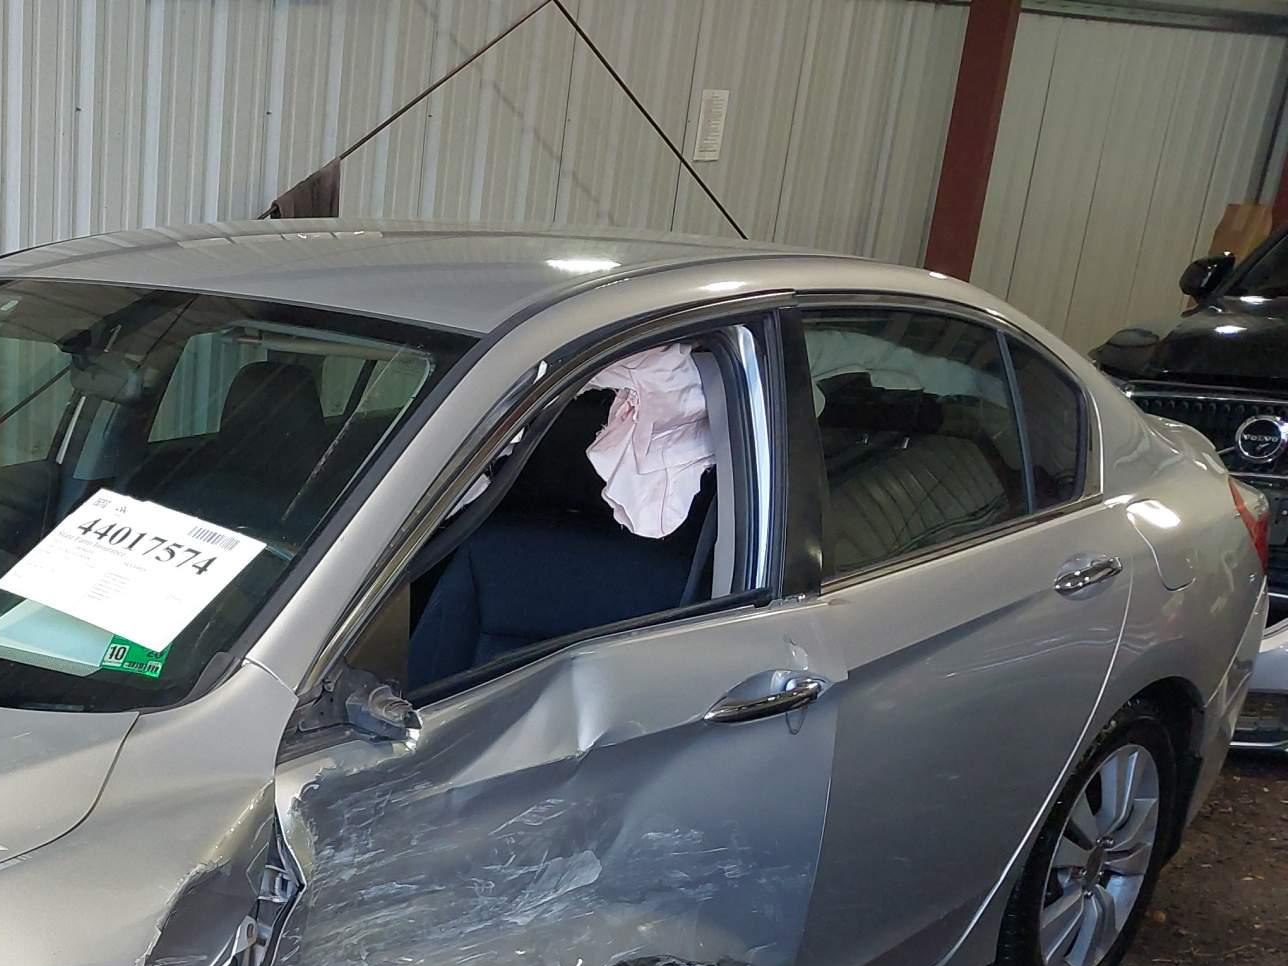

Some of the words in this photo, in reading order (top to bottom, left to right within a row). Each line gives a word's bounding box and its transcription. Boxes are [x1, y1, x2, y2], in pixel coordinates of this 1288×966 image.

[1242, 433, 1278, 442] VOLVO
[77, 518, 218, 576] 44017574
[109, 645, 127, 660] 10
